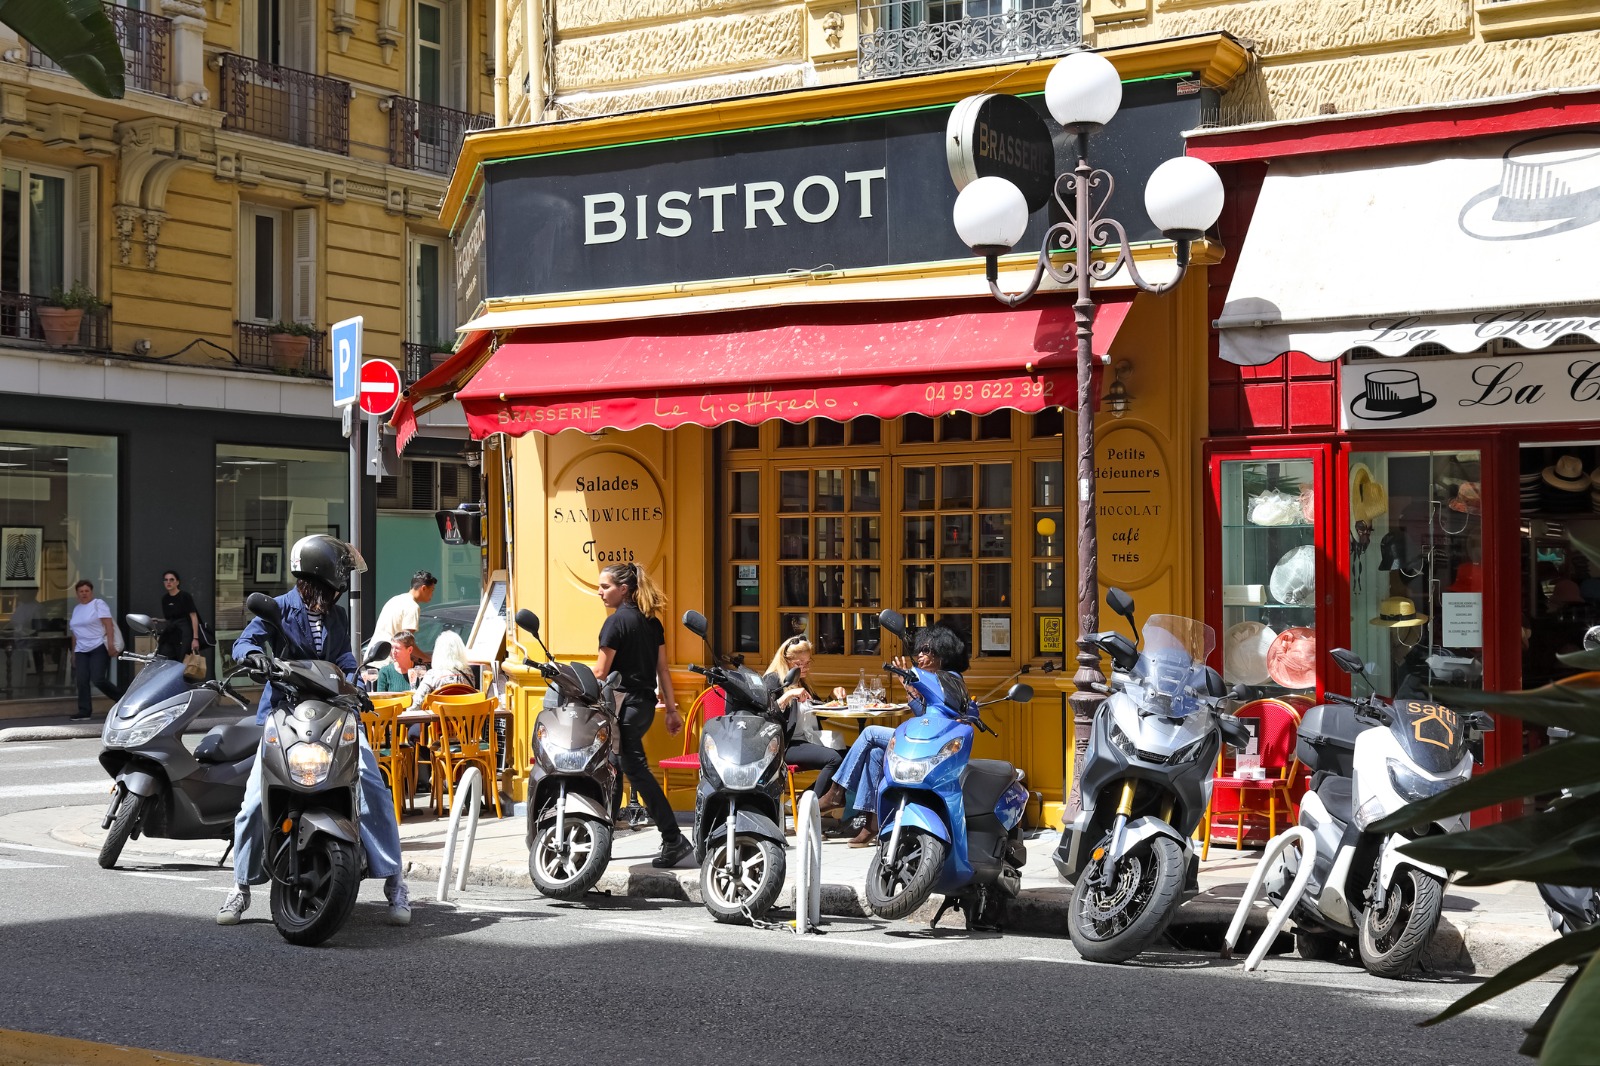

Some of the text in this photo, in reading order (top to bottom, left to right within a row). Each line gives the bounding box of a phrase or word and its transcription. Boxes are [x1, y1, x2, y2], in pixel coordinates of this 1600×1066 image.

[979, 121, 1050, 177] BRASSERIE
[583, 167, 886, 245] BISTROT
[1353, 316, 1440, 345] La
[338, 338, 351, 388] P
[1458, 359, 1600, 407] La C
[497, 381, 1054, 425] BRASSERIE Le Gioffredo 04 93 622 392
[1107, 448, 1146, 460] Petits
[576, 475, 639, 493] Salades
[1094, 467, 1160, 480] déjeuners
[554, 506, 663, 523] SANDWICHES
[1095, 505, 1161, 516] HOCOLAT
[1112, 527, 1140, 546] café
[582, 540, 634, 562] Toasts
[1112, 551, 1139, 562] THÉS
[1408, 702, 1456, 725] safti
